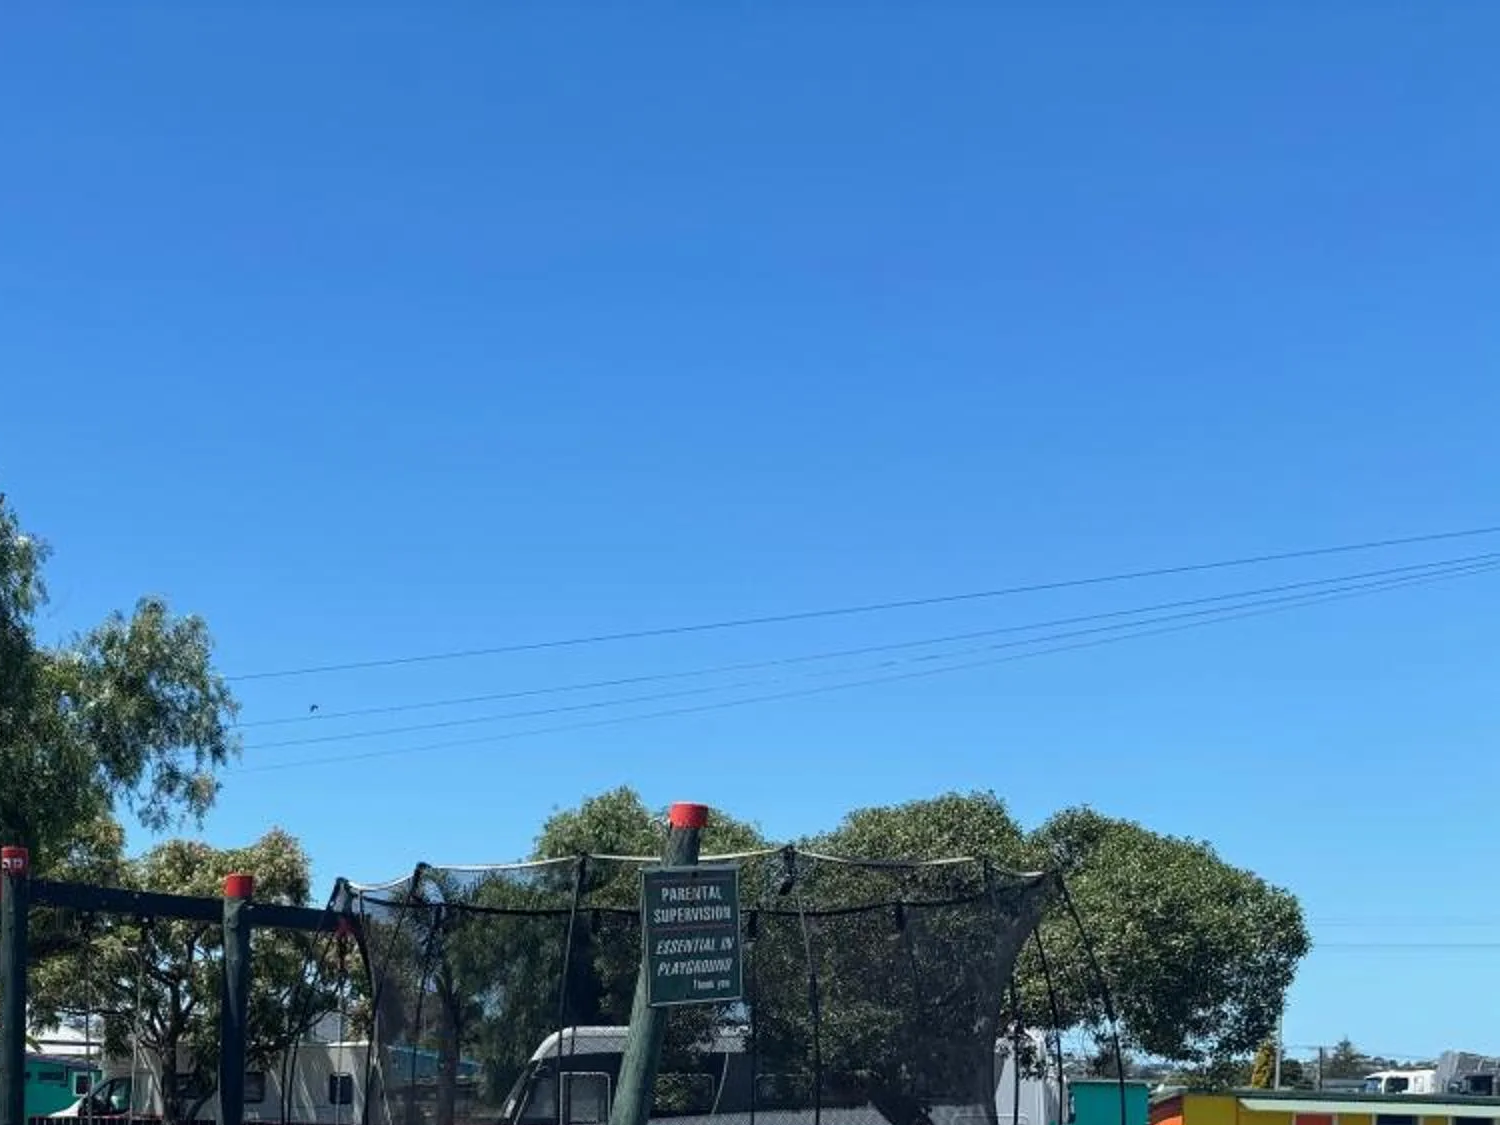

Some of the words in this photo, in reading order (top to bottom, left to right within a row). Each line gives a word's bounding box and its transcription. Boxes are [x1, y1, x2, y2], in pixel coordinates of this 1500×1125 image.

[661, 885, 722, 902] PARENTAL
[653, 905, 732, 924] SUPERVISION
[656, 937, 716, 955] ESSENTIAL
[721, 936, 735, 950] IN
[657, 958, 733, 976] PLAYGROUND
